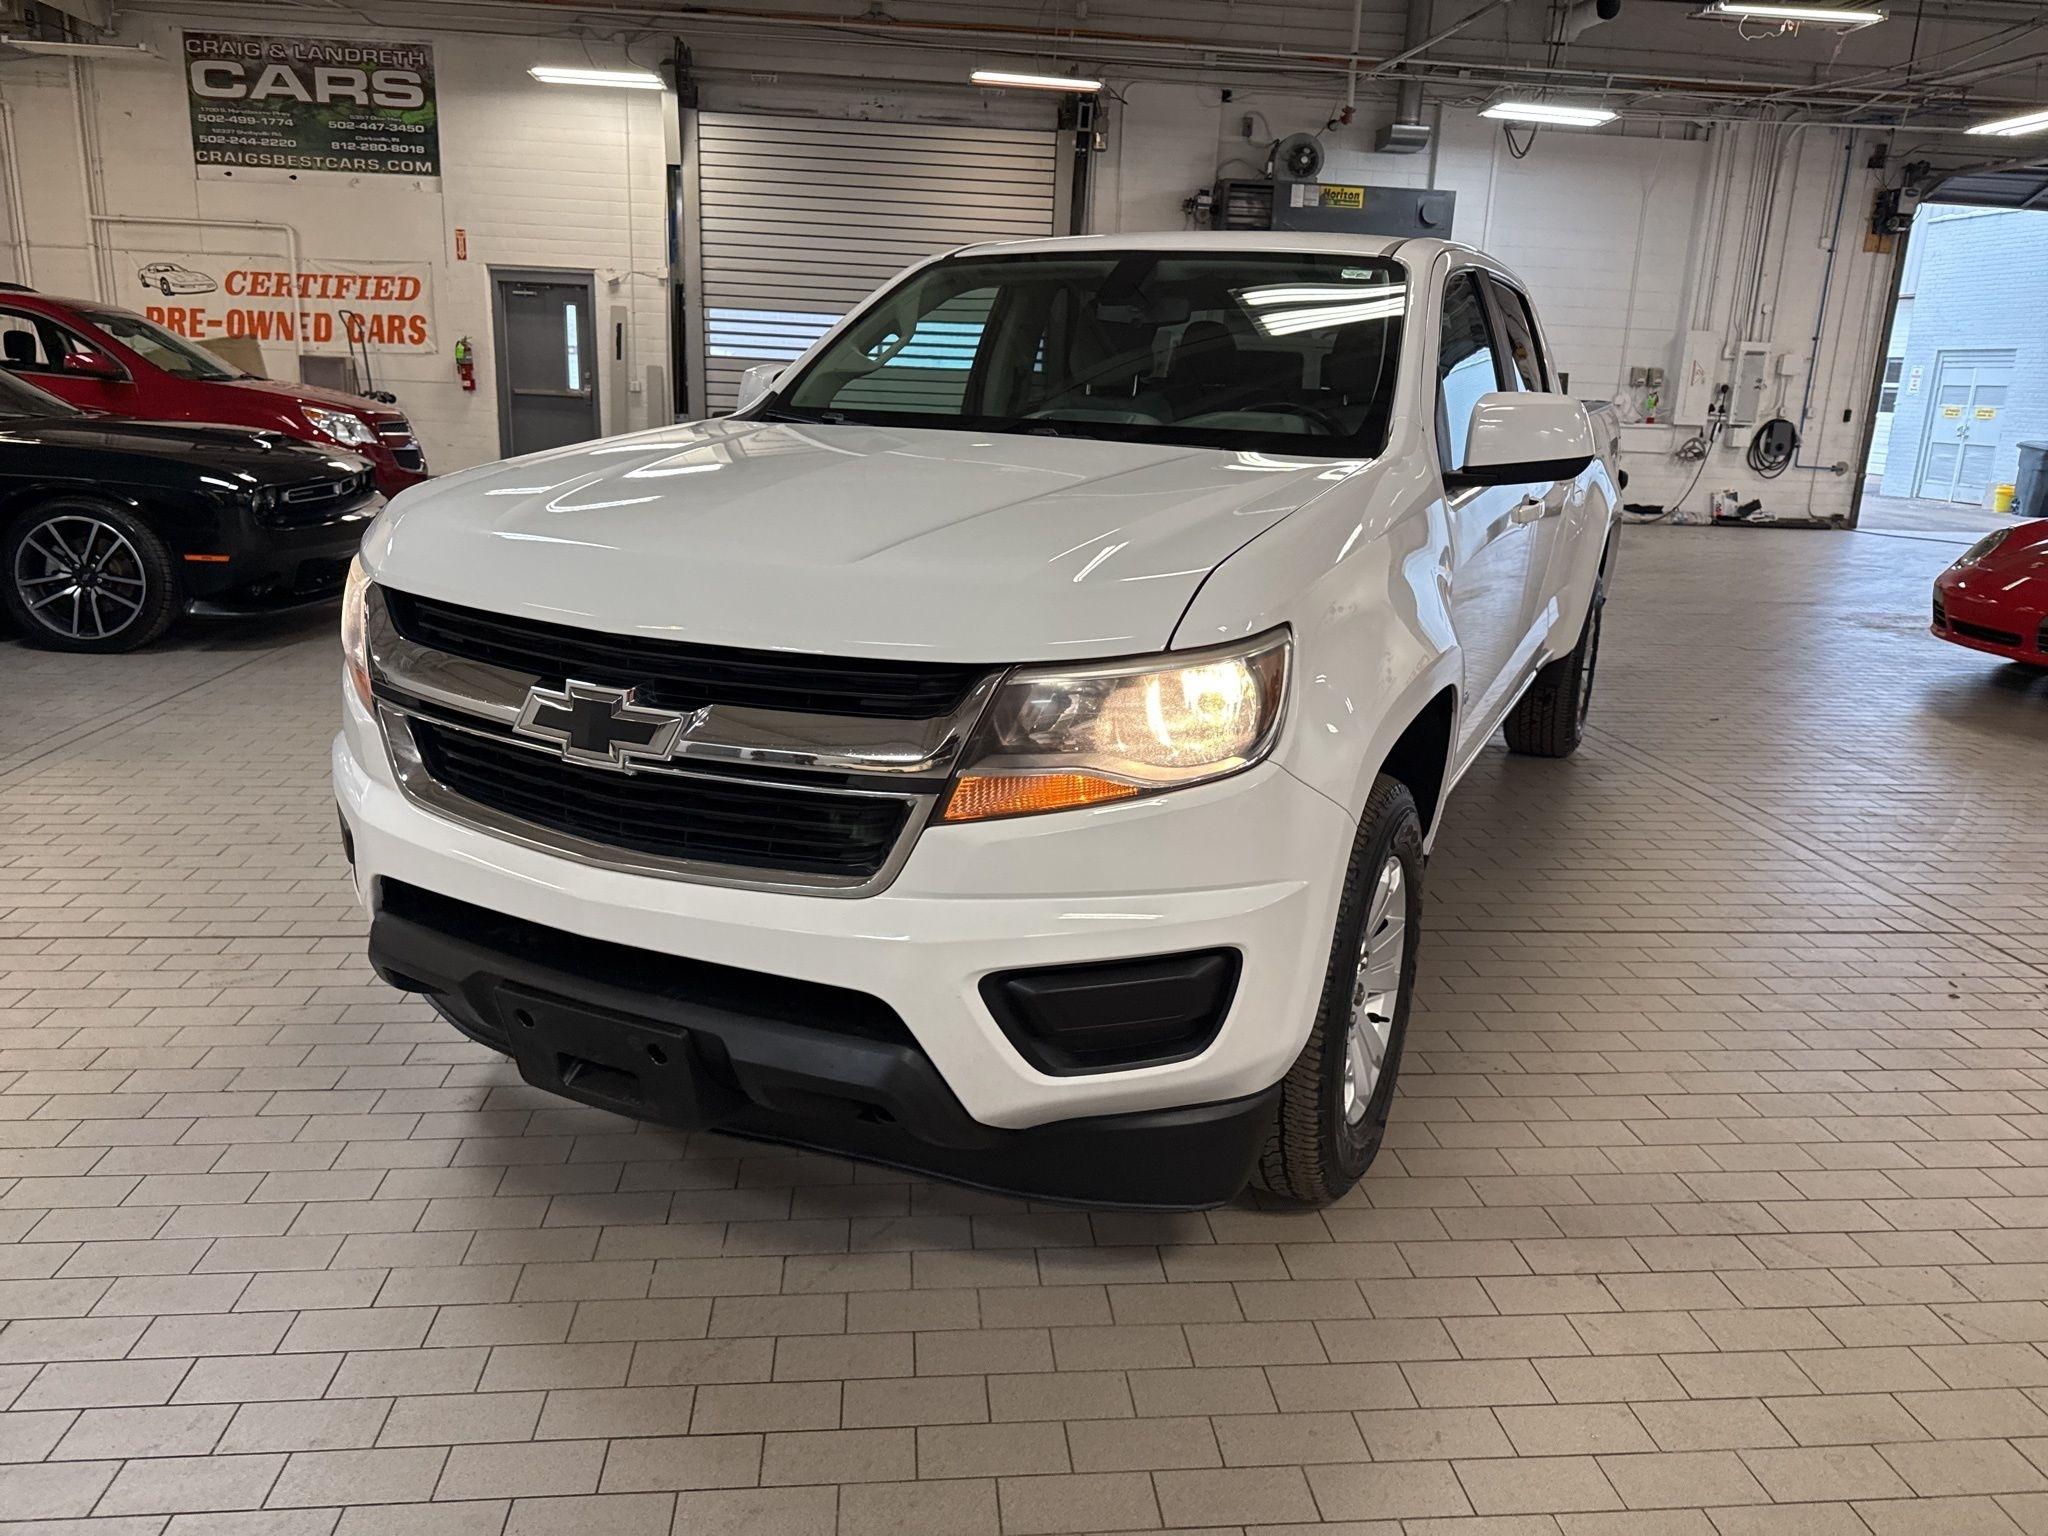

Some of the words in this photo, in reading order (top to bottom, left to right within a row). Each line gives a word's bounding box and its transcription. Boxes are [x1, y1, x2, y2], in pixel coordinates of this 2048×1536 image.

[185, 39, 261, 57] CRAIG
[269, 44, 287, 58] &
[294, 45, 425, 66] LANDRETH
[190, 60, 425, 108] CARS
[198, 113, 295, 127] 502-499-1774
[328, 120, 425, 134] 502-447-3450
[199, 134, 297, 148] 502-244-2220
[331, 141, 425, 154] 812-280-8018
[196, 150, 433, 173] CRAIGSBESTCARS.COM
[225, 270, 422, 301] CERTIFIED
[146, 306, 332, 343] PRE-OWNED
[347, 313, 427, 346] CARS
